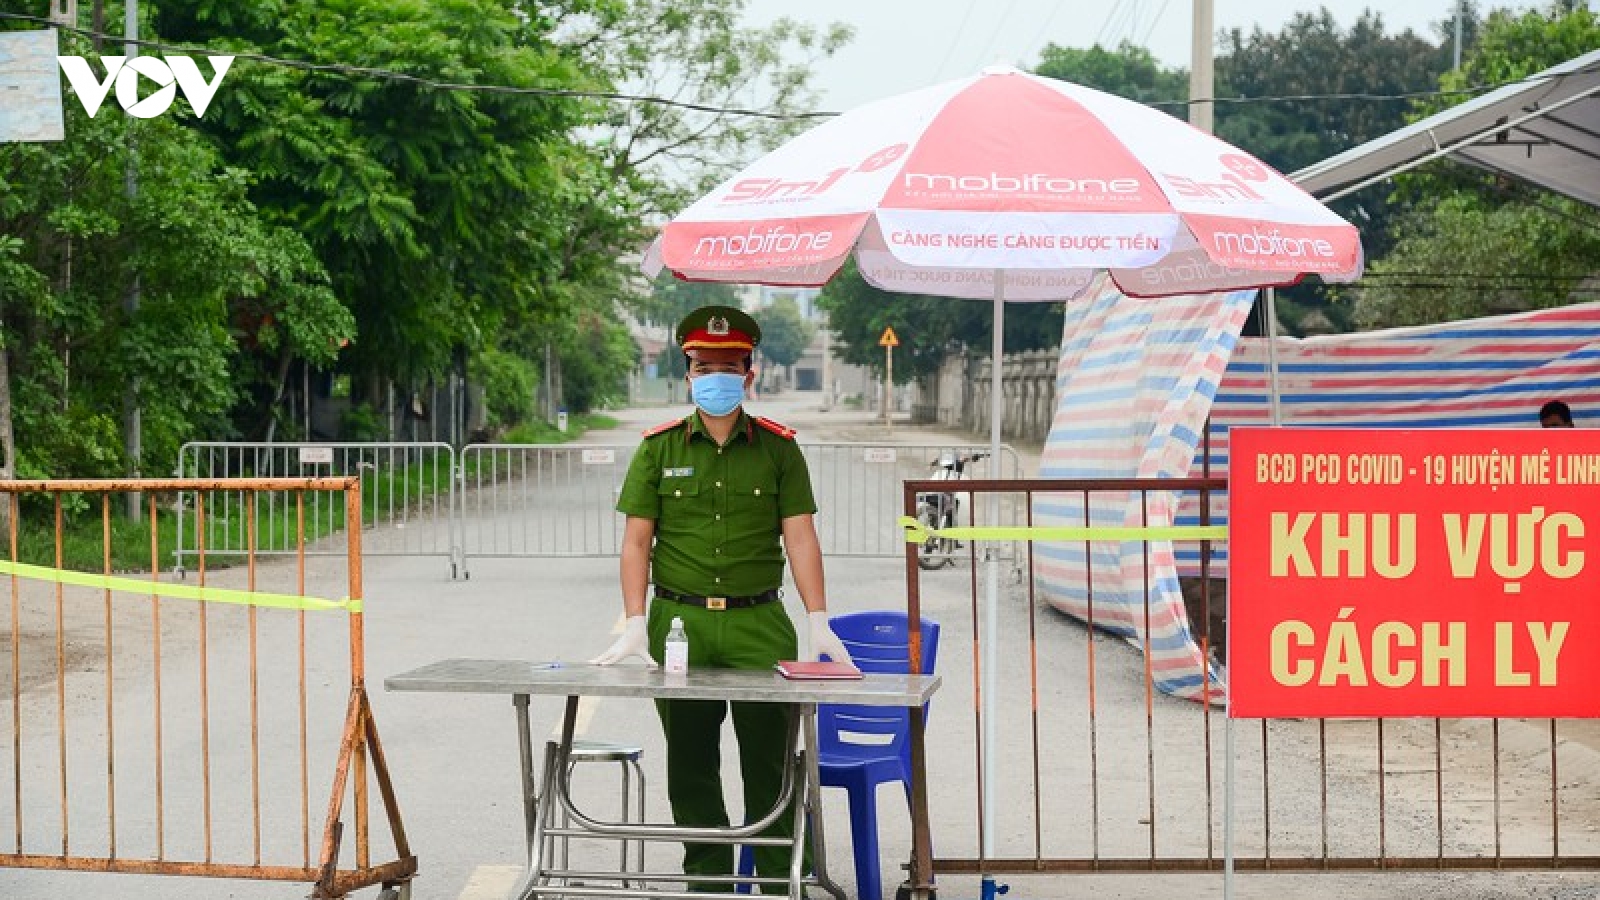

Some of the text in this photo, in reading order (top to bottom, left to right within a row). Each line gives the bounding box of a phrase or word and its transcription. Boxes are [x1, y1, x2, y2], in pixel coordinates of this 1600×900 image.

[905, 172, 1139, 192] mobifone
[693, 226, 833, 255] mobifone
[891, 230, 943, 247] CÀNG
[947, 233, 997, 249] NGHE
[1003, 233, 1055, 249] CÀNG
[1059, 235, 1112, 252] ĐƯỢC
[1213, 226, 1335, 257] mobifone
[1256, 448, 1600, 492] BCĐ PCD COVID - 19 HUYỆN MÊ LINH
[1269, 506, 1585, 593] KHU VỰC
[1269, 607, 1571, 688] CÁCH LY
